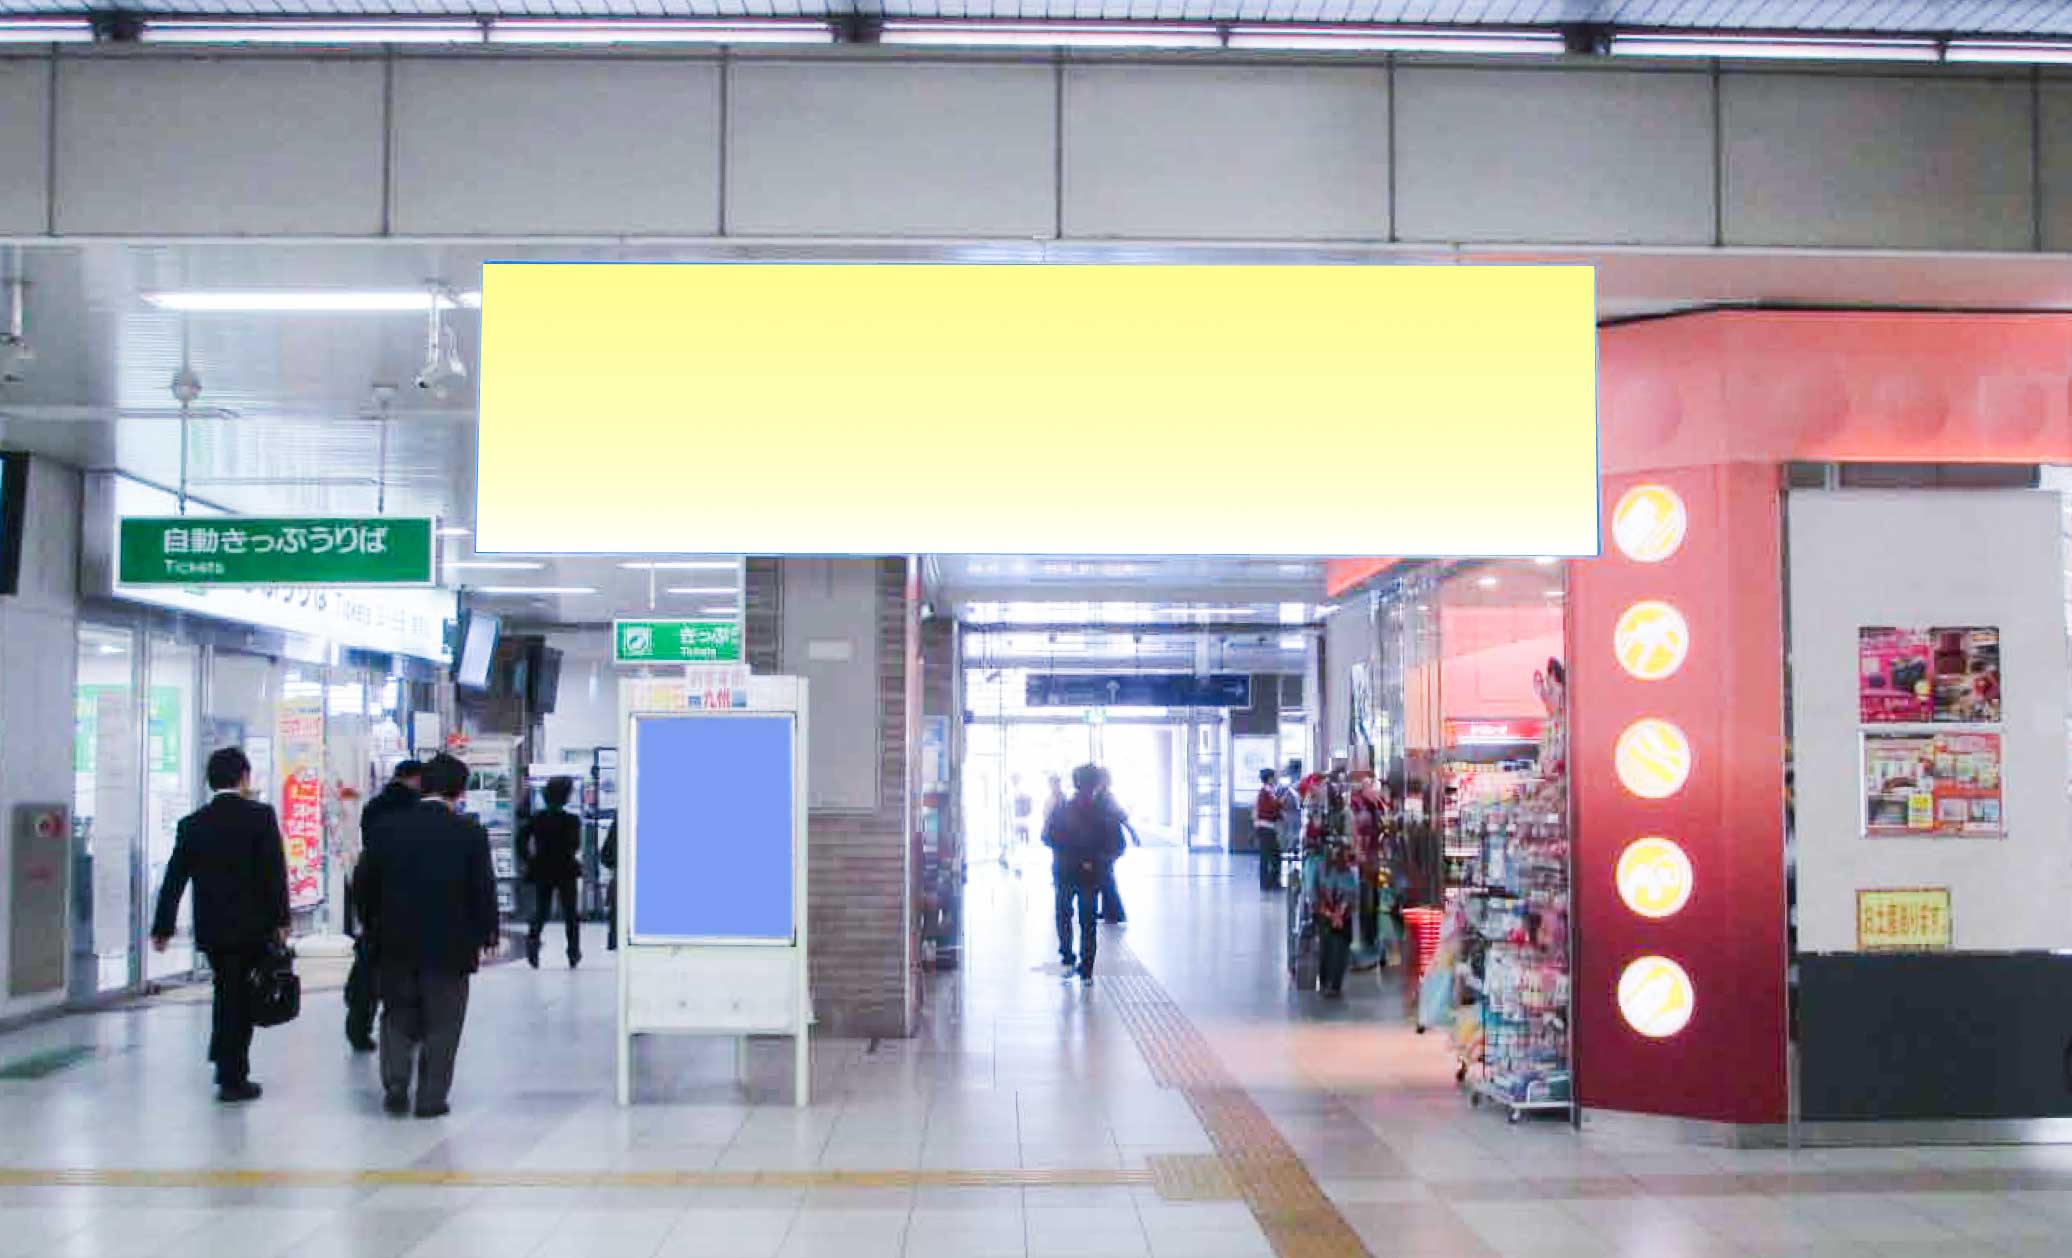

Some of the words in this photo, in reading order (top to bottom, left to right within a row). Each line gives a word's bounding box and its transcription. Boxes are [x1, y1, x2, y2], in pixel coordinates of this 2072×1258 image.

[163, 527, 388, 554] 自動きっぷうりば
[164, 559, 225, 575] Tickets
[703, 687, 731, 709] 九州
